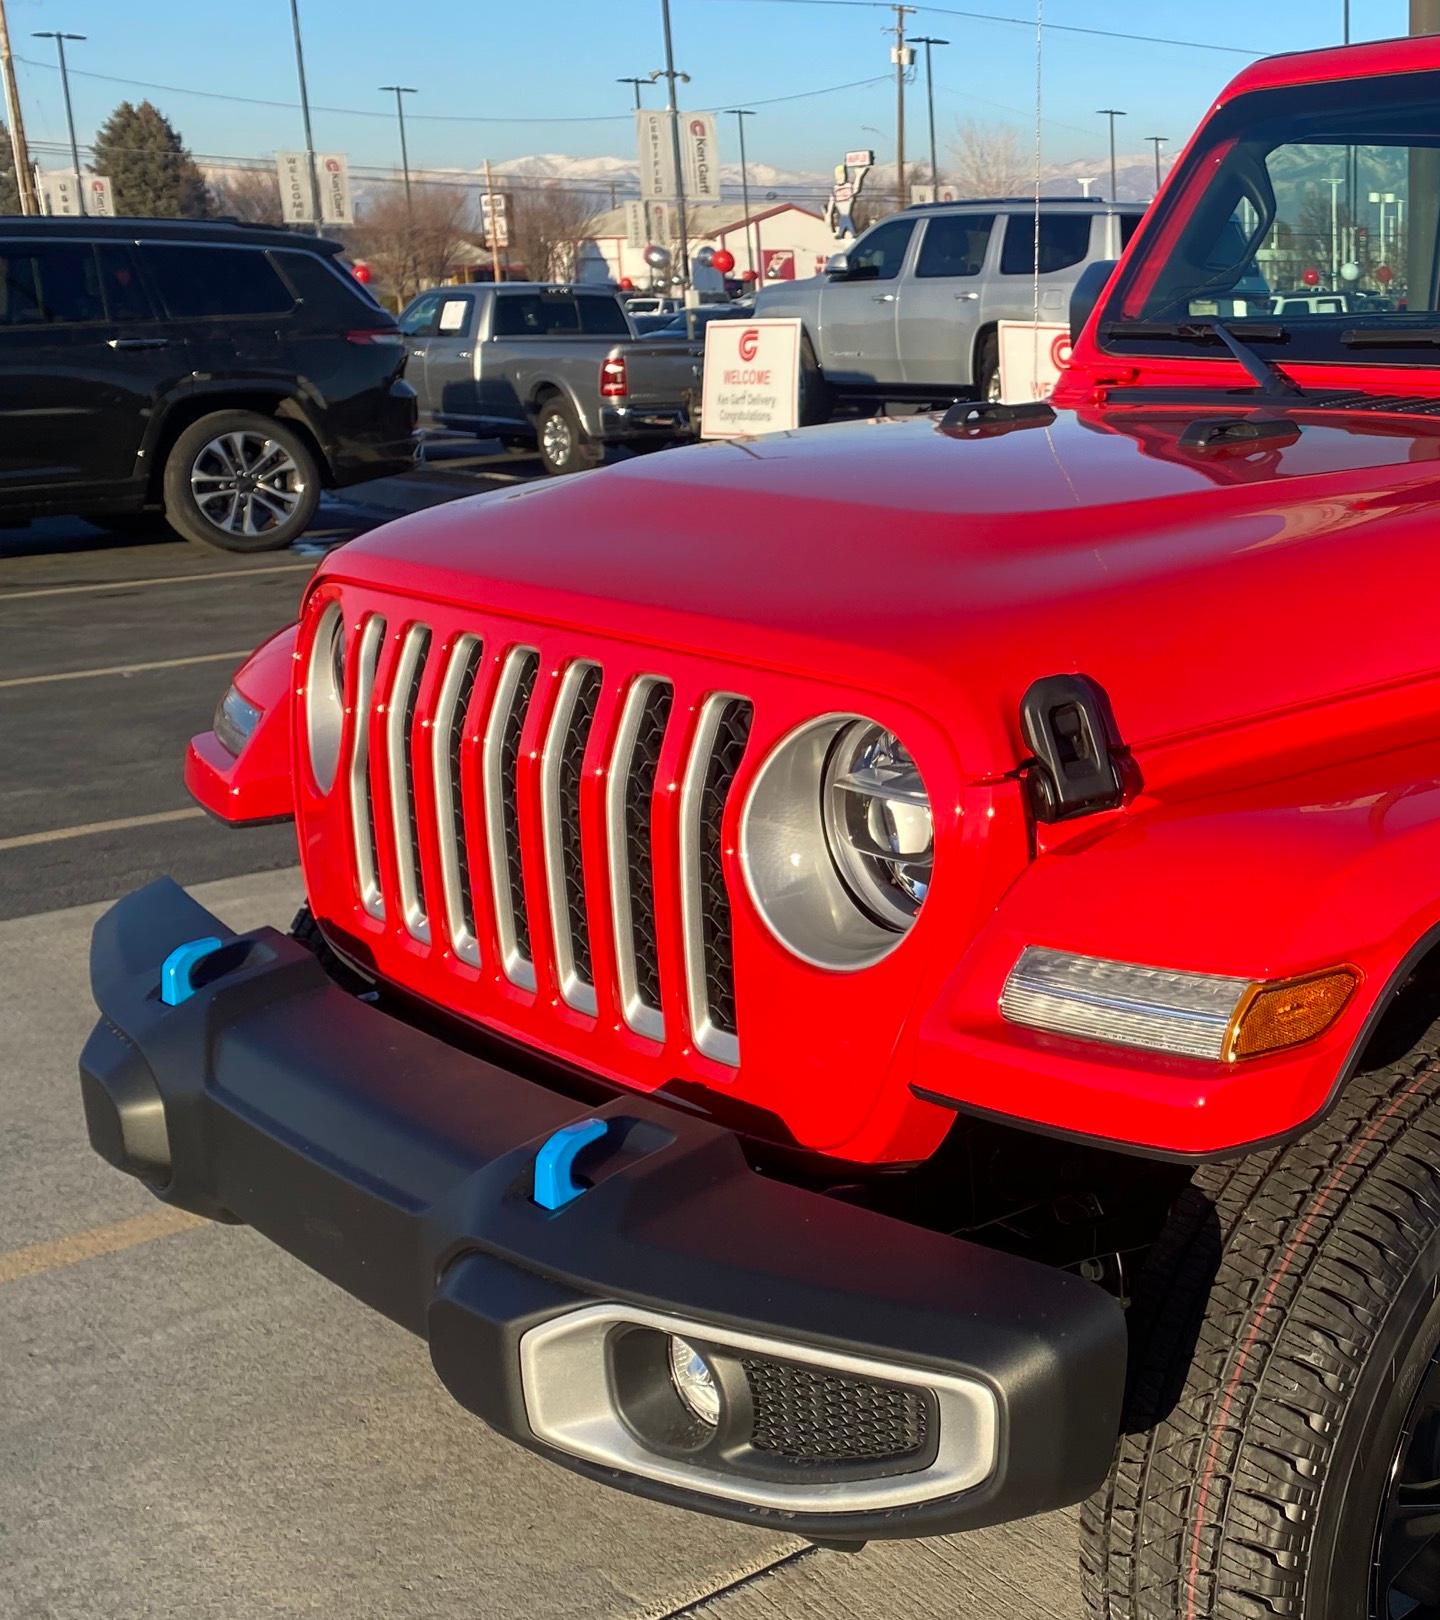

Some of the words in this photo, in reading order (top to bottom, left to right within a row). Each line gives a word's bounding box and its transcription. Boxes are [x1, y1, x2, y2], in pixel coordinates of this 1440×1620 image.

[648, 116, 663, 194] CERTIFIED
[695, 138, 707, 162] Ken
[286, 157, 305, 218] WELCOME
[697, 164, 711, 194] Garff
[723, 369, 772, 385] WELCOME
